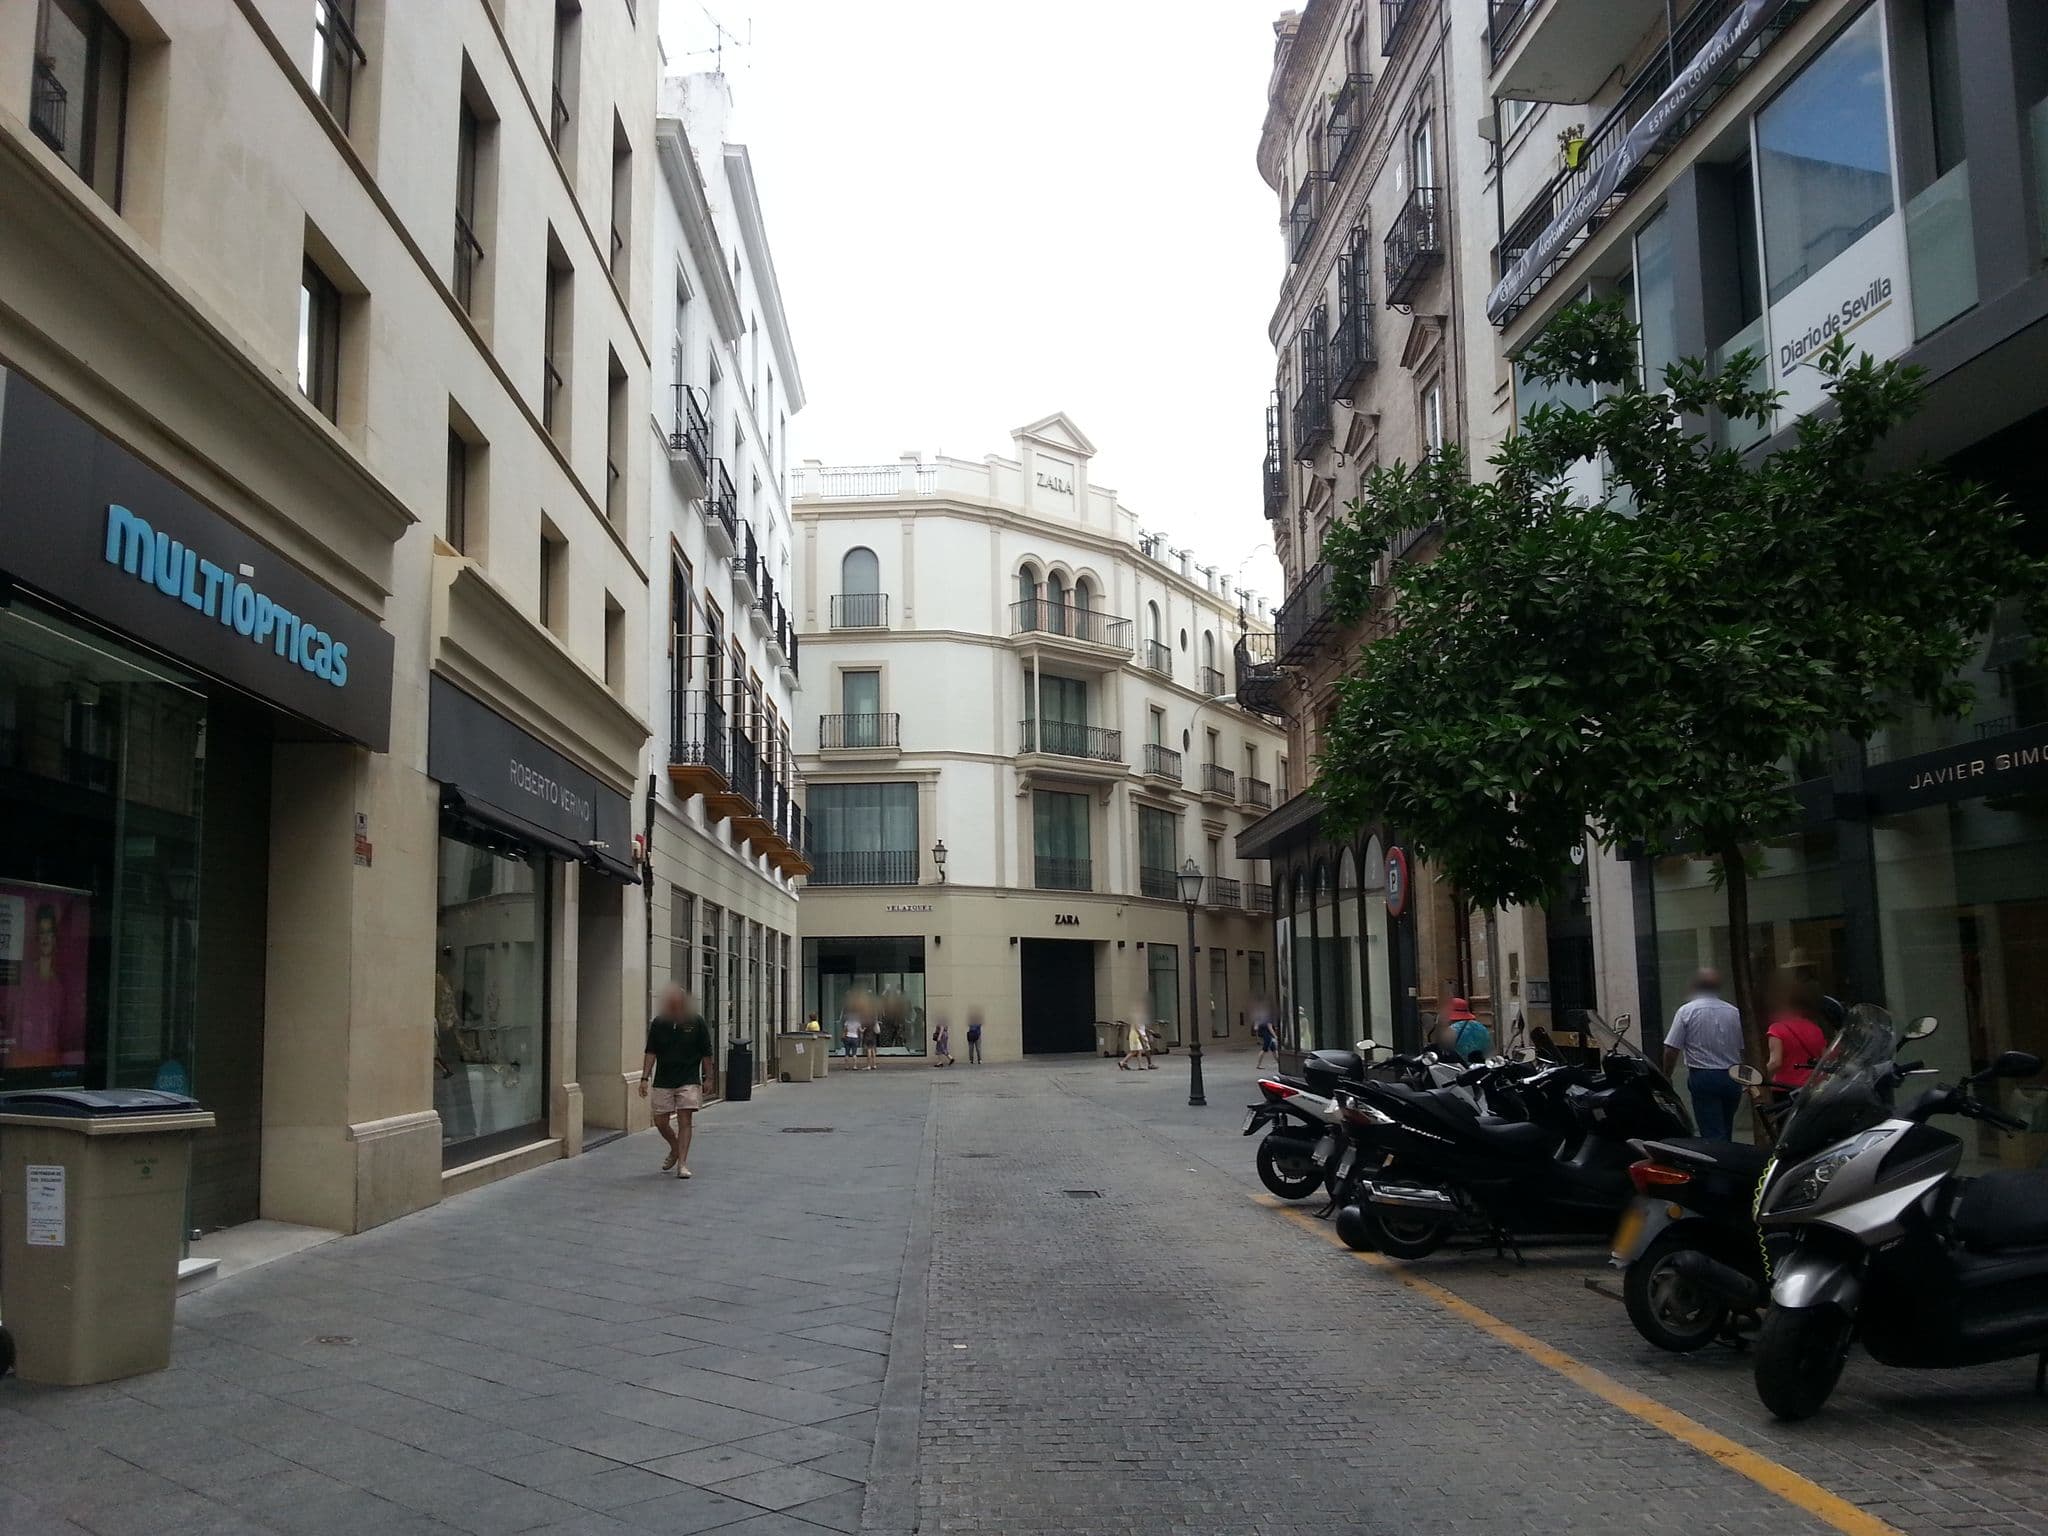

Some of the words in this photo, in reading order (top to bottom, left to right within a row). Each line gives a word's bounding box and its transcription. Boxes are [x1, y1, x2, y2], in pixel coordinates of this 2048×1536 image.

[1648, 86, 1687, 133] ESPACIO
[1688, 16, 1750, 88] COWORKING
[1781, 327, 1821, 369] Diario
[1823, 313, 1840, 339] de
[1841, 277, 1892, 326] Sevilla
[1037, 472, 1074, 496] ZARA
[510, 759, 558, 804] ROBERTO
[560, 786, 590, 821] VERINO
[1909, 760, 1985, 789] JAVIER
[1055, 914, 1080, 926] ZARA
